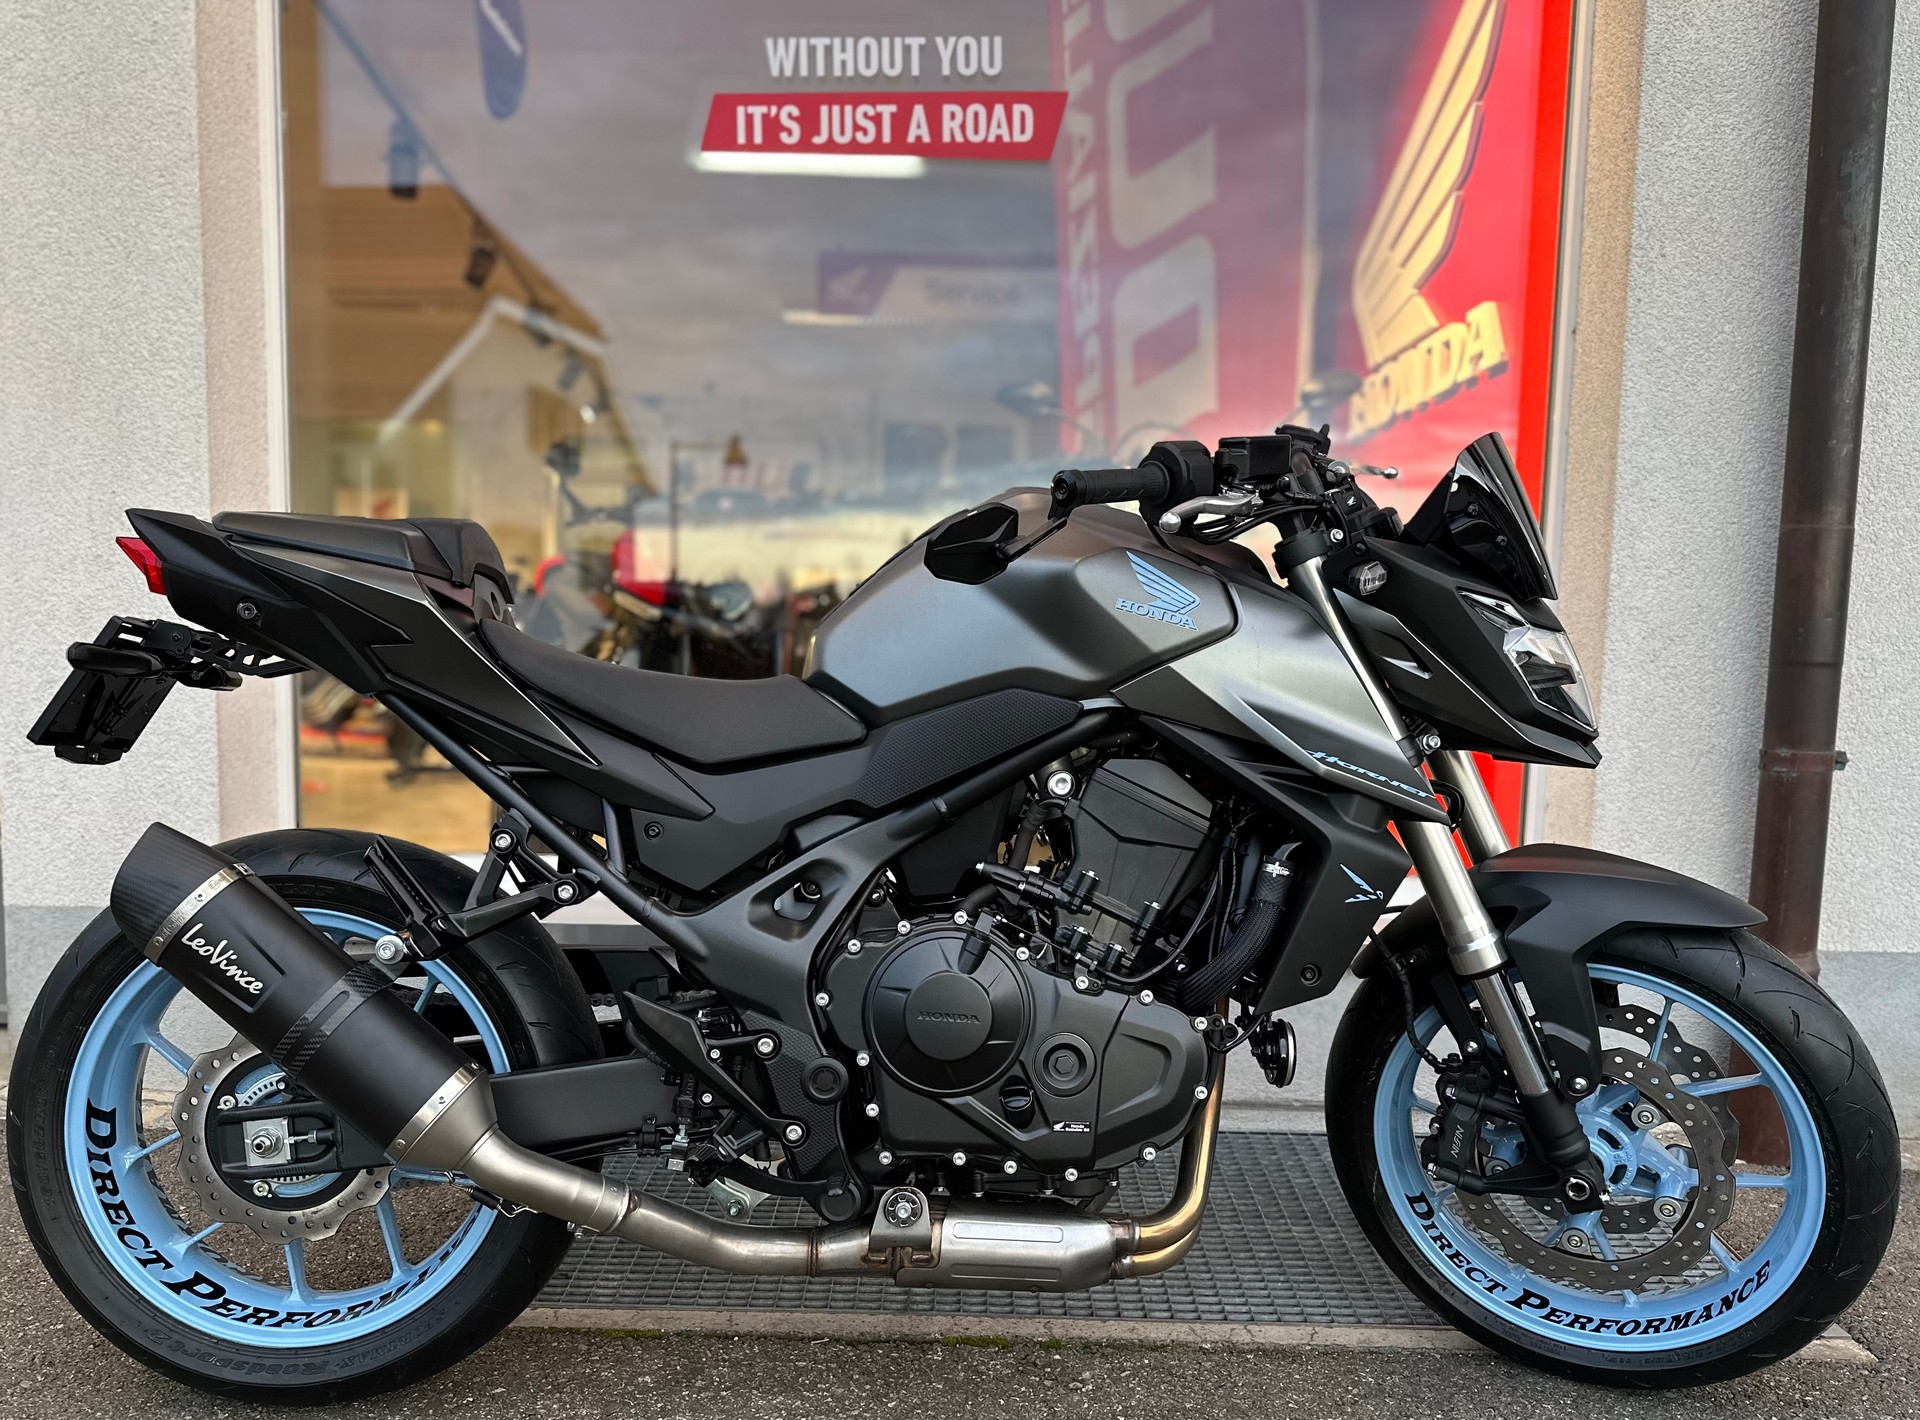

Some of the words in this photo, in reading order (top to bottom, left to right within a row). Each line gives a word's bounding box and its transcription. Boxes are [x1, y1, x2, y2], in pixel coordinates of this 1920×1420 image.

[764, 37, 925, 77] WITHOUT
[936, 36, 1002, 76] YOU
[736, 105, 801, 144] IT'S
[811, 104, 897, 144] JUST
[907, 104, 931, 143] A
[942, 104, 1034, 143] ROAD
[1115, 597, 1198, 631] HONDA
[181, 923, 264, 994] LeoVince
[917, 1011, 981, 1024] HONDA
[86, 1097, 175, 1271] DIRECT
[1404, 1192, 1508, 1293] DIRECT
[1505, 1260, 1771, 1336] PERFORMANCE
